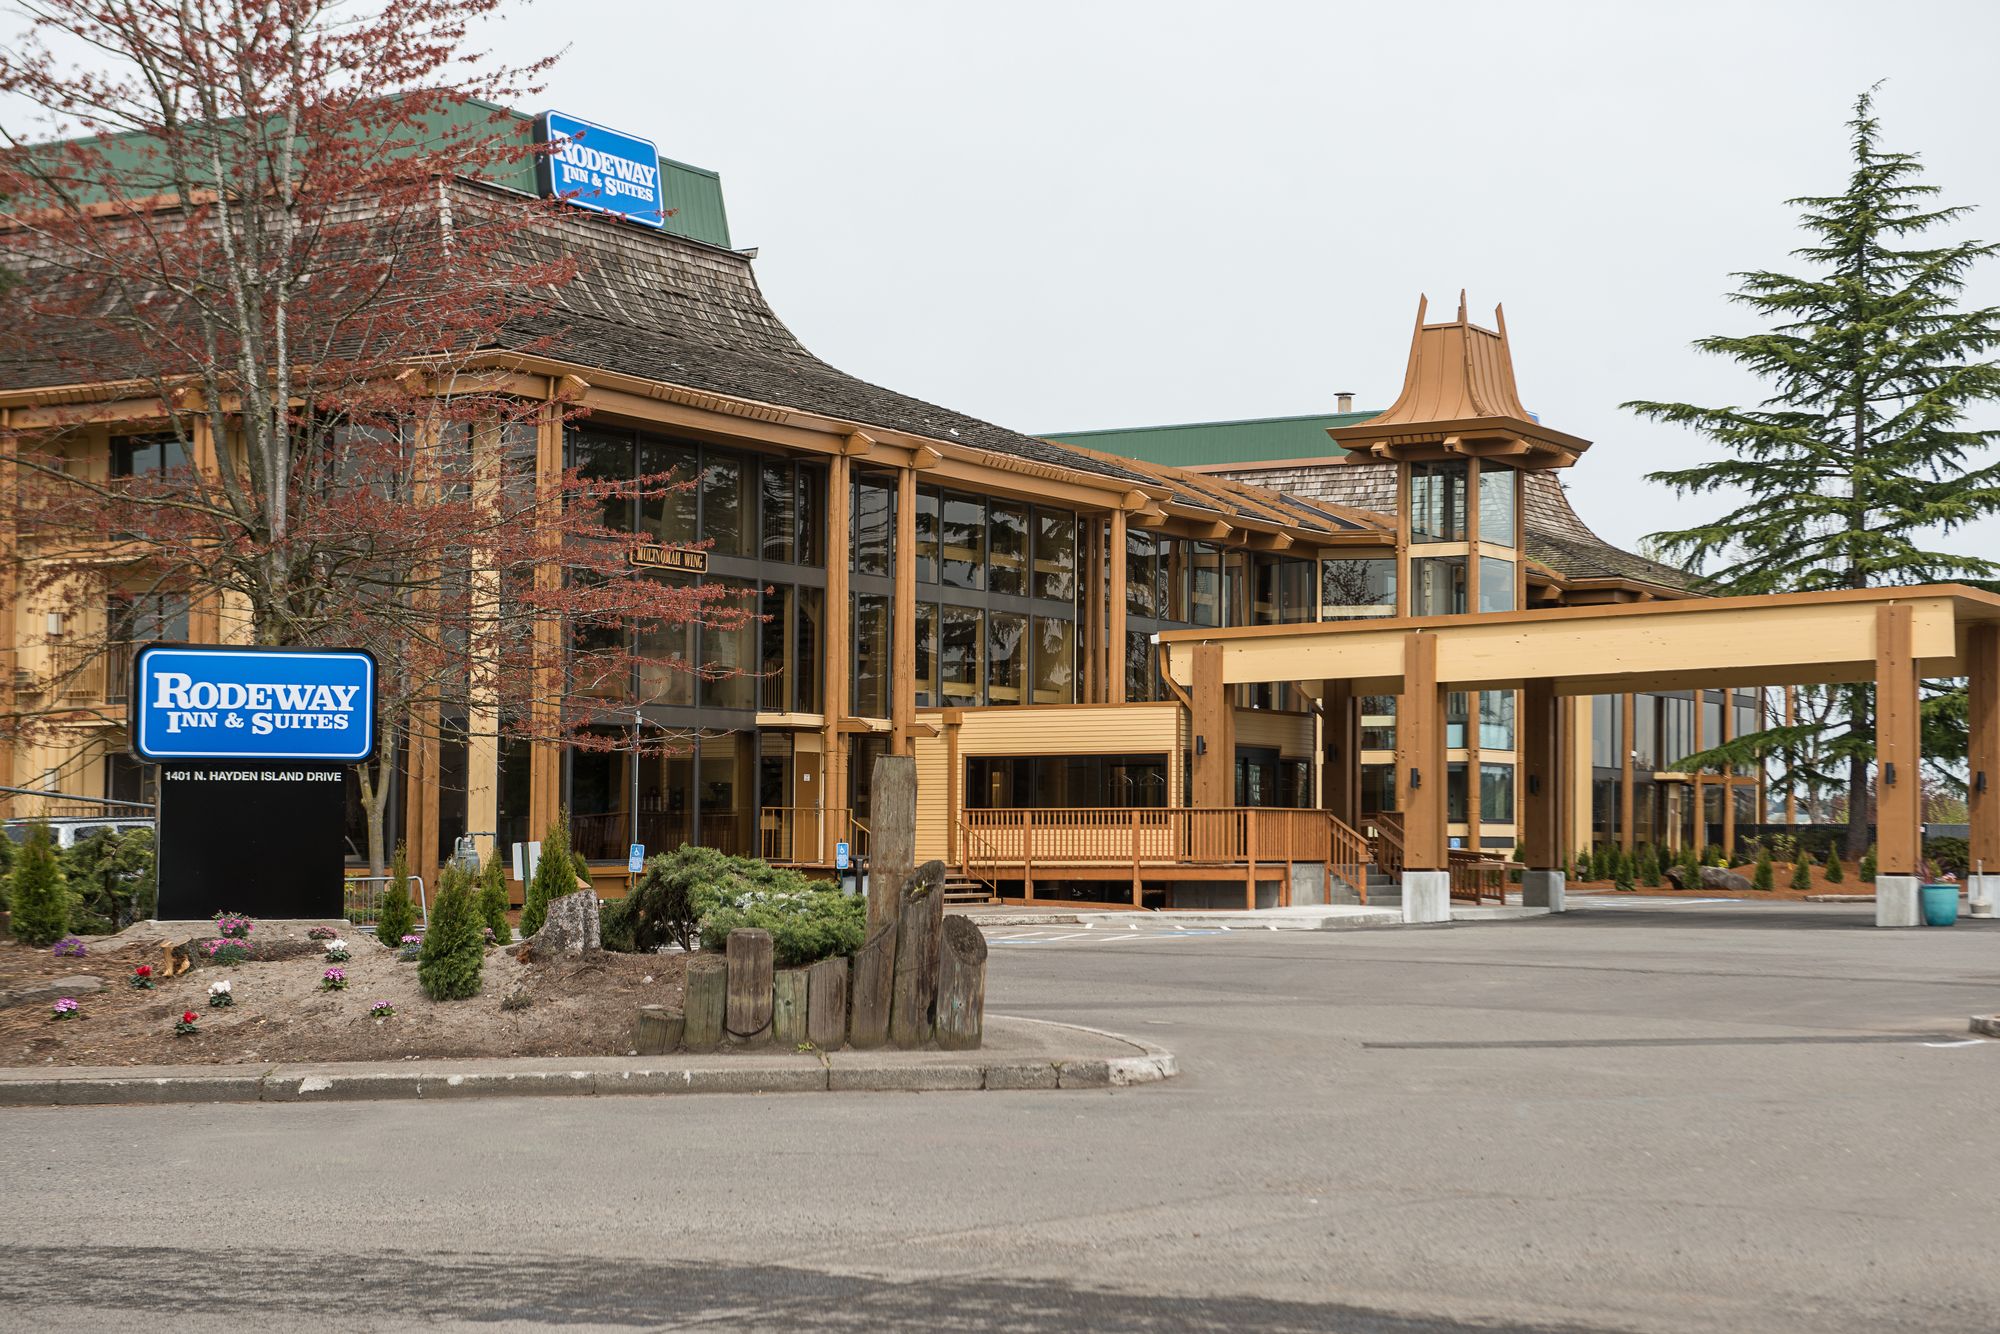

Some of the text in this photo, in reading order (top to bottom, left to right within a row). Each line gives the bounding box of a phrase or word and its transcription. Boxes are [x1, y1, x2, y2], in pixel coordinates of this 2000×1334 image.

[552, 129, 656, 188] RODEWAY
[562, 164, 654, 202] INN & SUITES
[684, 553, 703, 568] WING
[153, 672, 360, 712] RODEWAY
[166, 711, 349, 735] INN & SUITES
[165, 771, 342, 782] 1401 N. HAYDEN ISLAND DRIVE
